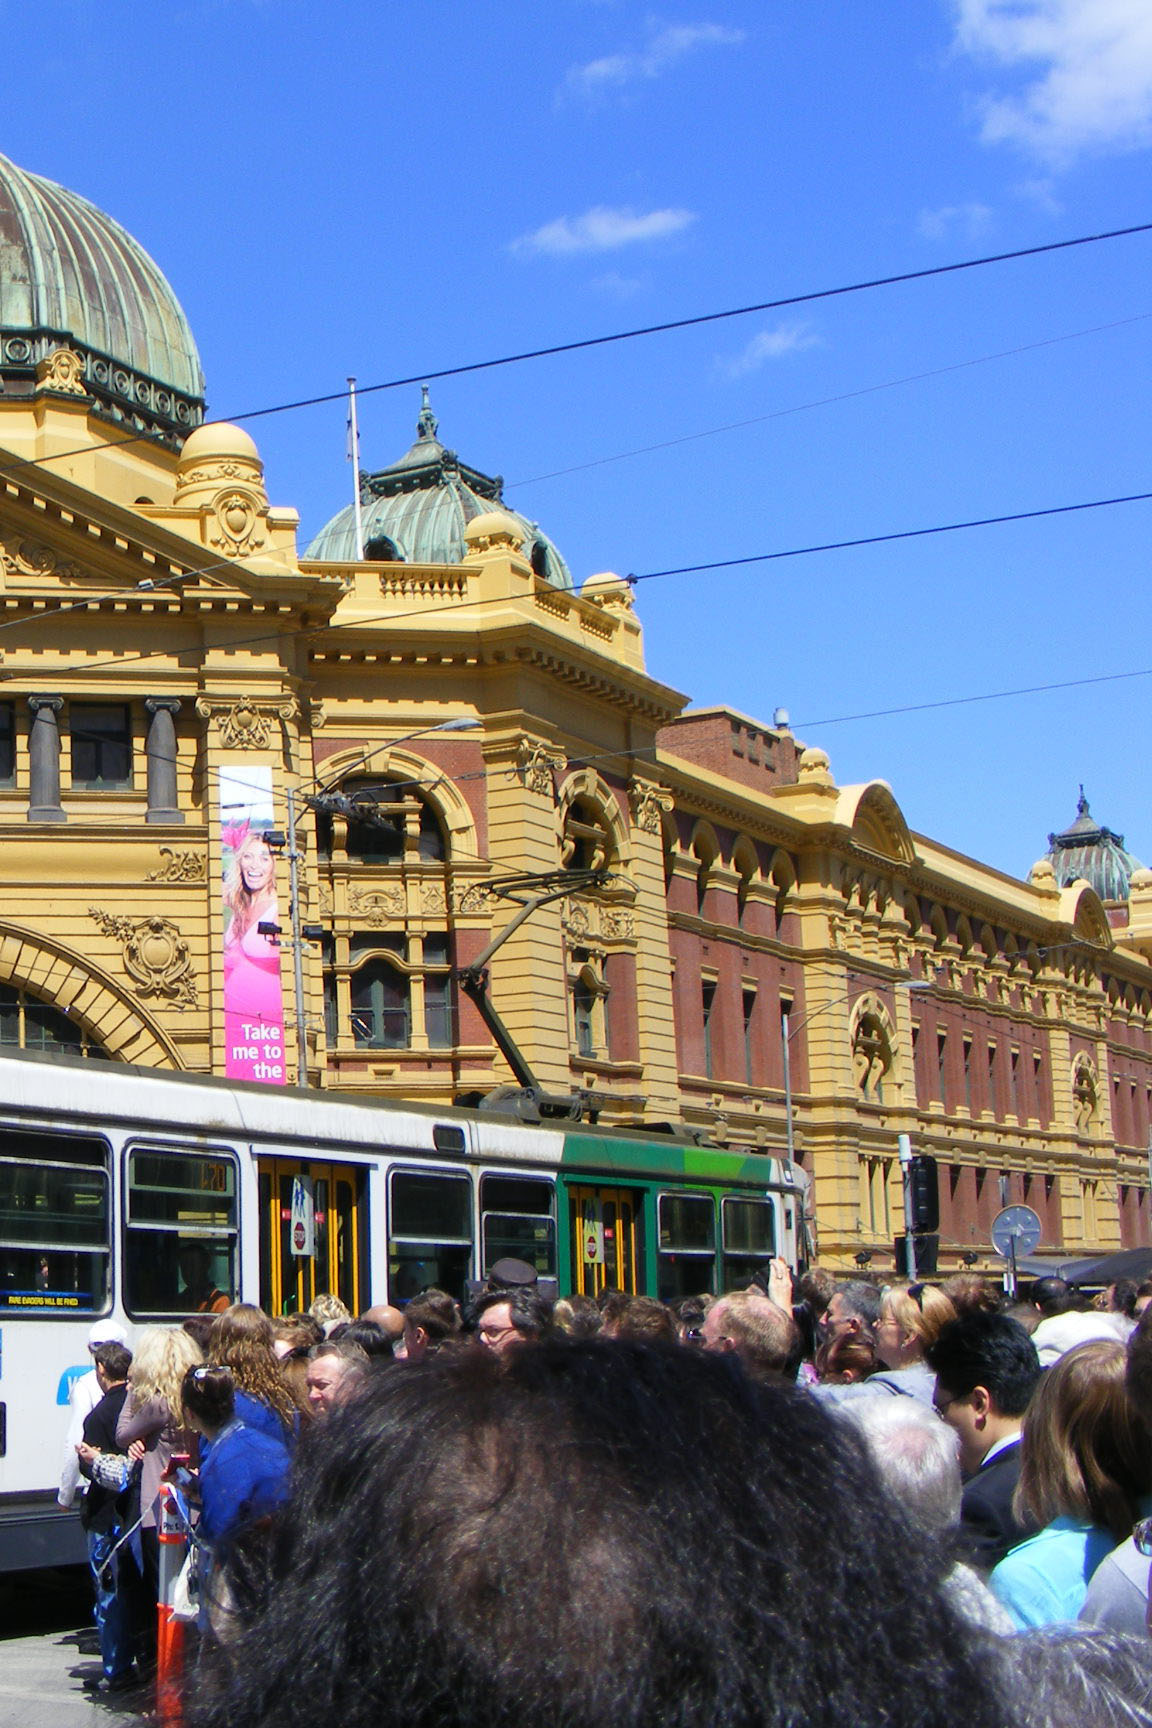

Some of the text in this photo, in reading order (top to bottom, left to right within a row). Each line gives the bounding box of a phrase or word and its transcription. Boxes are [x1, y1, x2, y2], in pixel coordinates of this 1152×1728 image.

[241, 1024, 281, 1040] Take
[232, 1044, 282, 1060] me to
[252, 1061, 283, 1079] the
